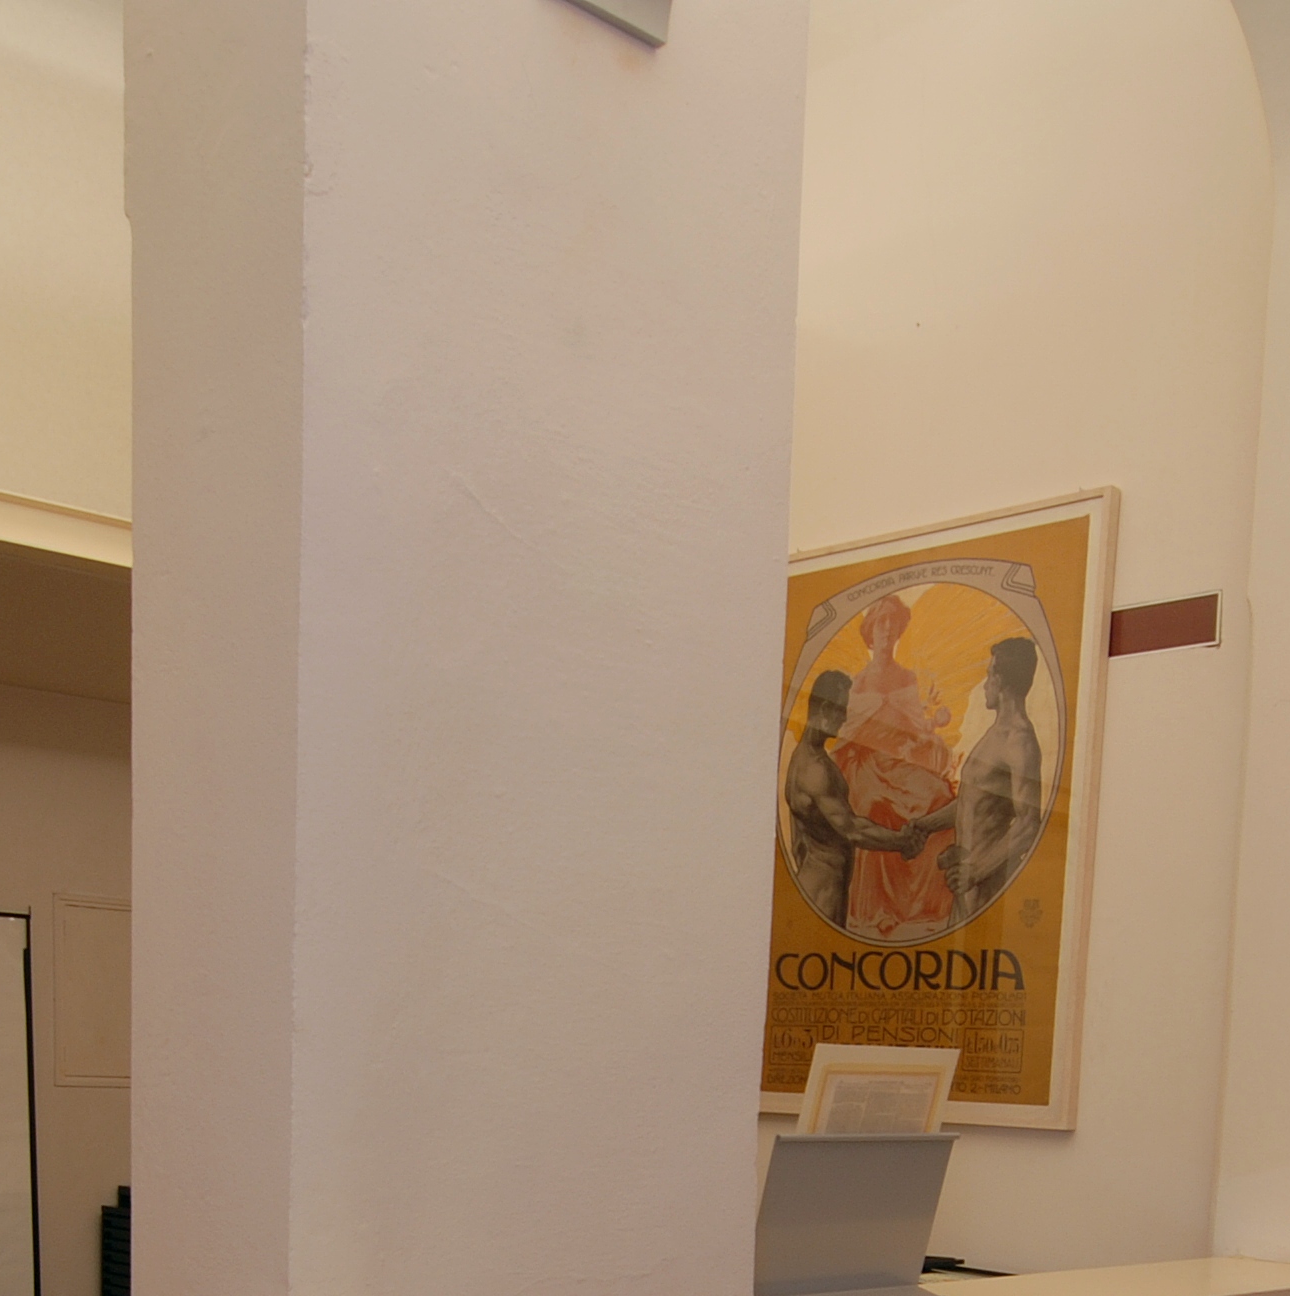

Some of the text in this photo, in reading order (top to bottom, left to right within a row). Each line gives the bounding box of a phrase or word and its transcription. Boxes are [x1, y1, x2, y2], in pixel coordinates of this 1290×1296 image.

[775, 949, 1025, 991] CONCORDIA
[942, 1008, 1027, 1027] DOTAZIONI
[822, 1025, 839, 1041] DI
[852, 1026, 959, 1044] PENSIONI
